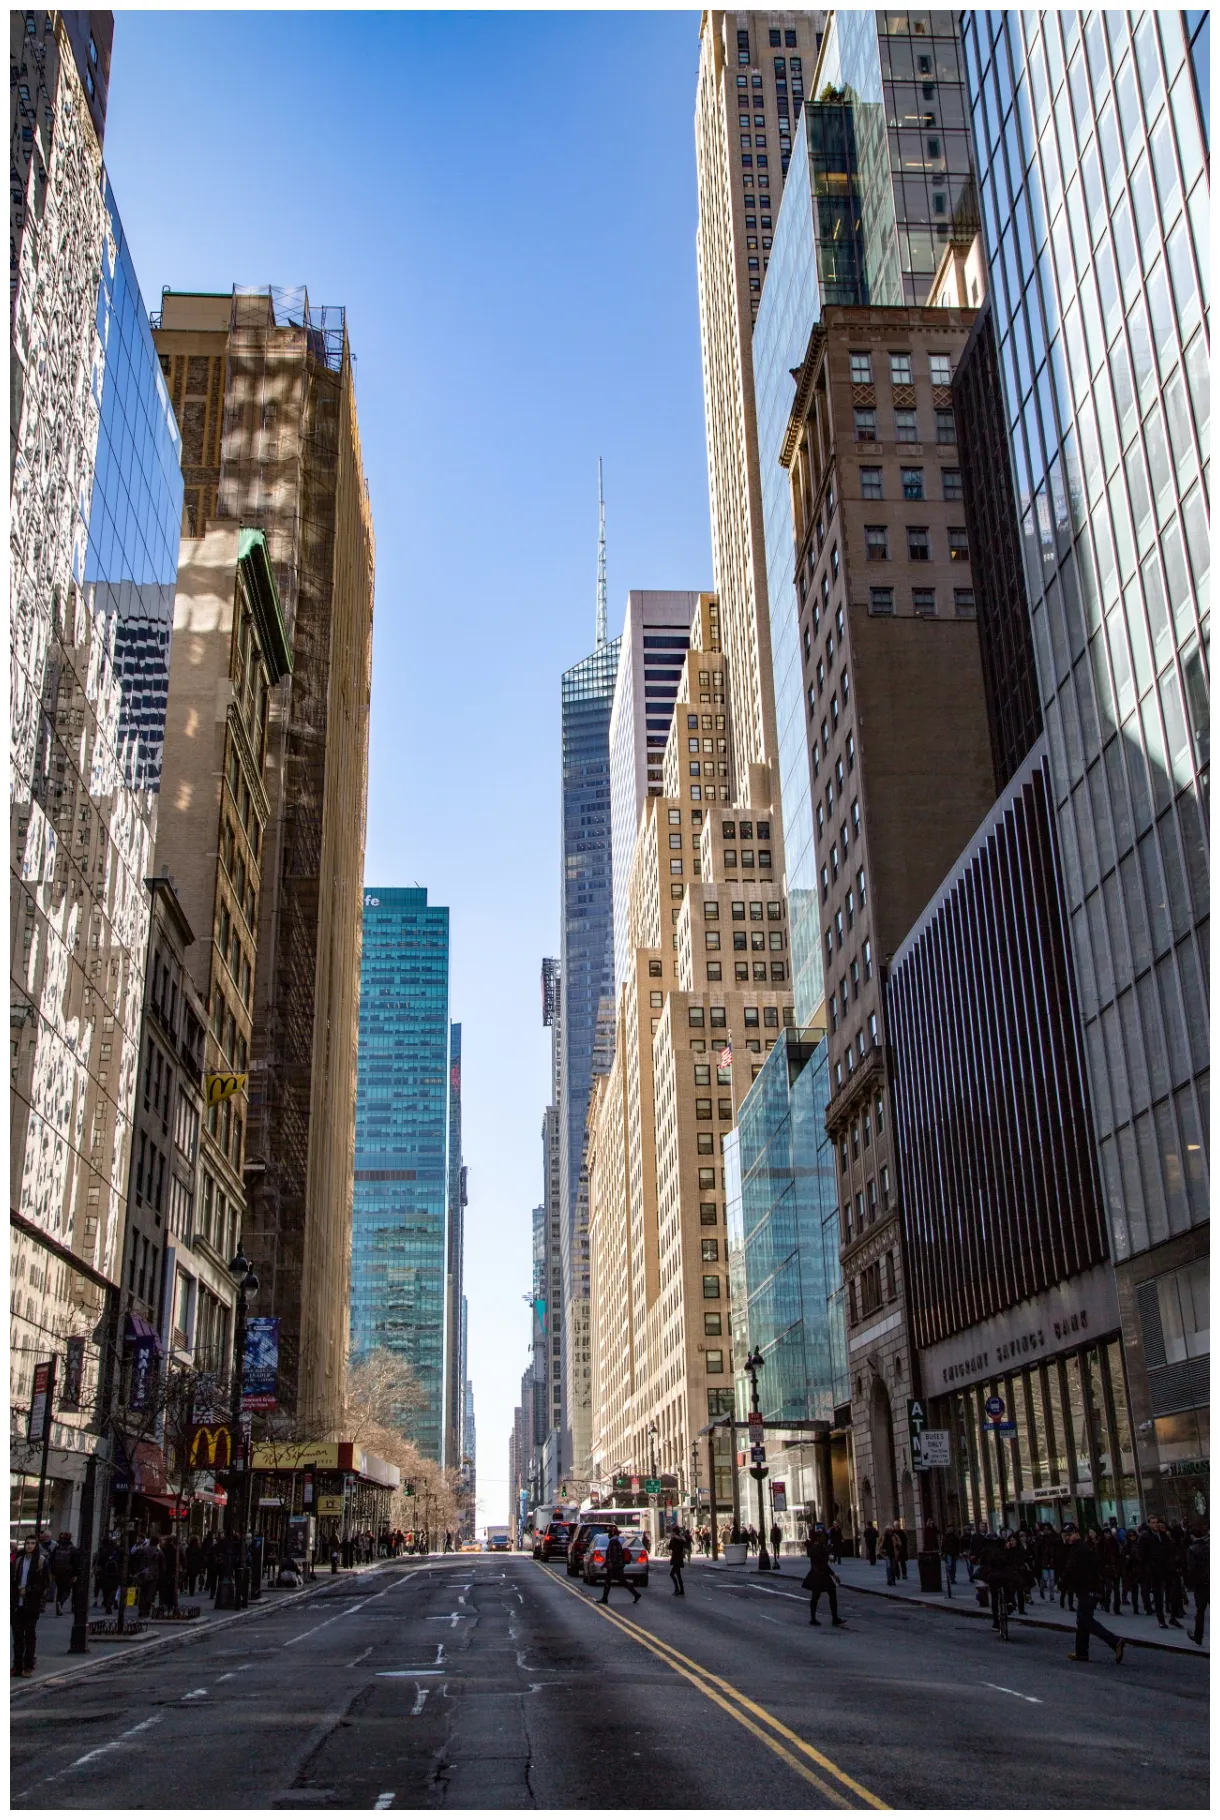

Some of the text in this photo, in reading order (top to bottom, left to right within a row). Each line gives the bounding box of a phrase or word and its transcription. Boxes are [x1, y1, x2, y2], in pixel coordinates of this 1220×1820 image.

[942, 1309, 1089, 1383] EMIGRANT SAVINGS BANK
